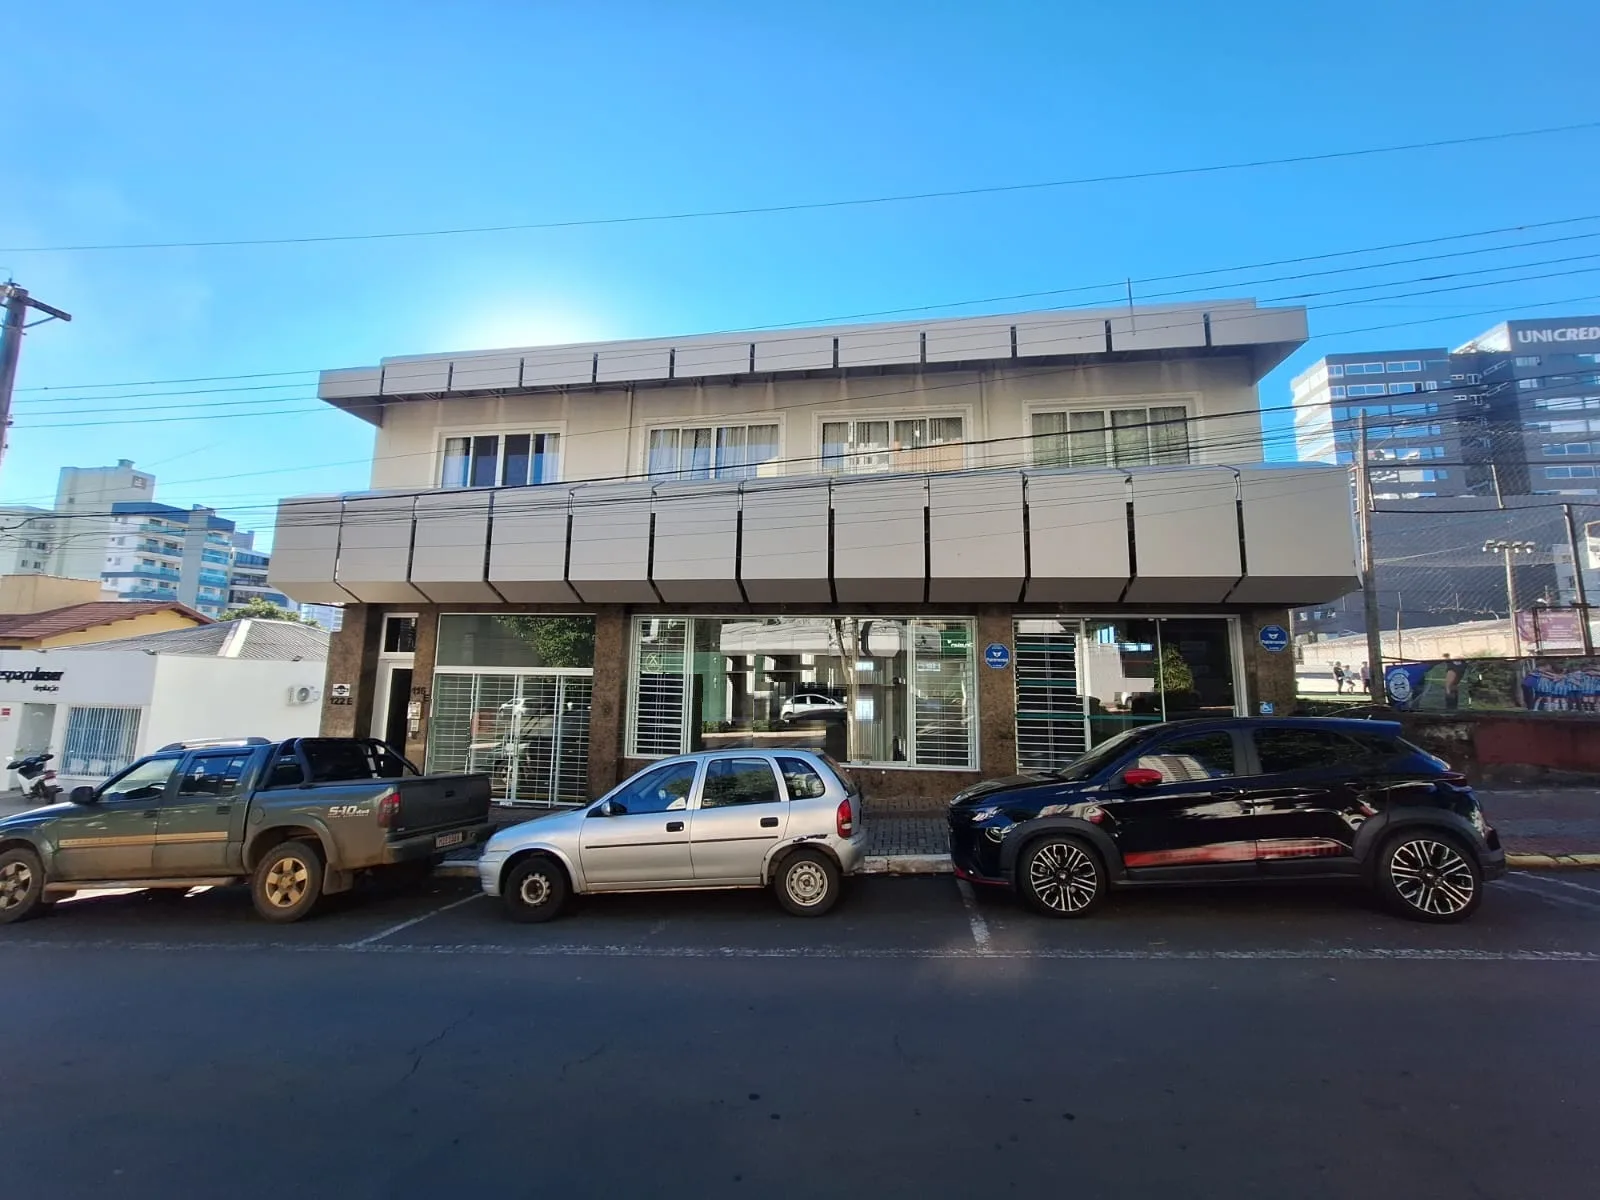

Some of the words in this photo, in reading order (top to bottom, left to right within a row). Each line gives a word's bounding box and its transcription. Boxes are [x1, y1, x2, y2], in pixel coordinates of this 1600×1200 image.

[1517, 327, 1600, 343] UNICRED
[330, 697, 346, 705] 122
[346, 697, 353, 705] E
[329, 805, 358, 815] S-10
